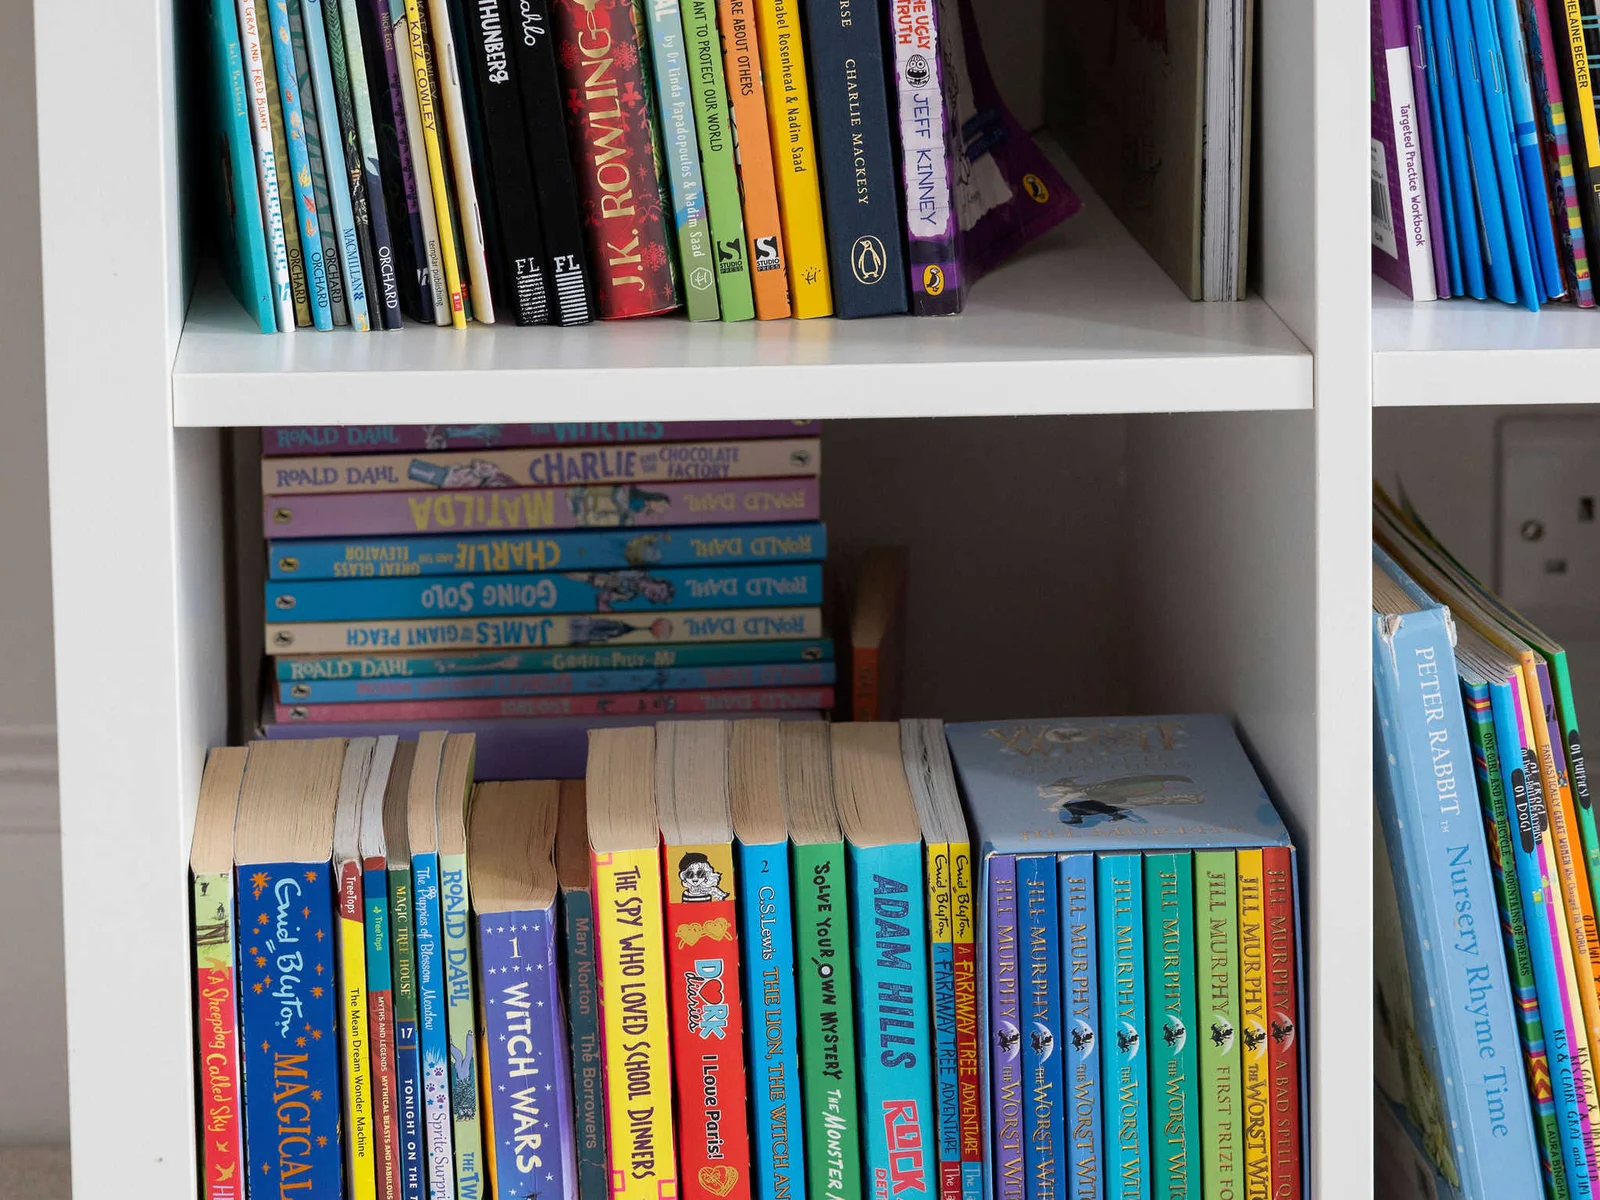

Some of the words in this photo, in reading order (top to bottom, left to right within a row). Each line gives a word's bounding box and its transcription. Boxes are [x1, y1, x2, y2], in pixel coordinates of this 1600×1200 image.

[244, 8, 256, 35] GRAY
[381, 12, 391, 30] Nick
[410, 21, 423, 58] KATZ
[695, 23, 708, 37] TO
[733, 18, 749, 53] ABOUT
[915, 16, 930, 50] UGLY
[250, 43, 259, 61] AND
[383, 33, 393, 51] East
[662, 34, 674, 48] by
[667, 52, 678, 63] Dr
[252, 70, 263, 93] FRED
[668, 67, 685, 98] Linda
[698, 41, 713, 87] PROTECT
[736, 57, 753, 96] OTHERS
[778, 34, 798, 92] Rosenhead
[1573, 46, 1588, 88] BECKER
[416, 68, 435, 131] COWLEY
[702, 89, 718, 110] OUR
[845, 58, 861, 126] CHARLIE
[256, 98, 268, 130] BLUNT
[578, 31, 635, 219] ROWLING
[706, 113, 723, 152] WORLD
[787, 108, 802, 143] Nadim
[913, 93, 930, 138] JEFF
[1400, 105, 1414, 148] Targeted
[671, 101, 693, 178] Papadopoulos
[792, 147, 806, 172] Saad
[852, 133, 869, 204] MACKESY
[1405, 152, 1419, 192] Practice
[917, 150, 936, 225] KINNEY
[684, 193, 700, 226] Nadim
[1411, 195, 1425, 247] Workbook
[343, 228, 361, 291] MACMILLAN
[429, 240, 439, 267] templar
[608, 229, 645, 291] J.K.
[689, 230, 703, 257] Saad
[290, 248, 306, 304] ORCHARD
[311, 252, 328, 308] ORCHARD
[325, 248, 341, 303] ORCHARD
[379, 246, 397, 309] ORCHARD
[433, 269, 444, 306] publishing
[277, 468, 338, 487] ROALD
[347, 466, 398, 484] DAHL
[529, 452, 636, 485] CHARLIE
[659, 448, 739, 468] CHOCOLATE
[668, 463, 729, 478] FACTORY
[409, 488, 554, 531] MATILDA
[334, 564, 374, 577] GLASS
[345, 546, 408, 563] ELEVATOR
[380, 562, 419, 576] GREAT
[455, 541, 560, 571] CHARLIE
[347, 628, 399, 646] PEACH
[408, 624, 457, 645] GIANT
[477, 618, 553, 645] JAMES
[684, 618, 735, 636] DAHL
[744, 616, 804, 634] ROALD
[291, 661, 351, 679] ROALD
[361, 658, 412, 676] DAHL
[1415, 647, 1445, 720] PETER
[1484, 733, 1494, 750] ONE
[1429, 728, 1460, 816] RABBIT
[1487, 753, 1499, 776] GIRL
[1542, 744, 1560, 807] FANTASTICALLY
[1572, 758, 1589, 798] PUPPIES!
[1491, 778, 1501, 796] AND
[1493, 799, 1504, 817] HER
[1517, 803, 1530, 832] DOG!
[1553, 810, 1564, 834] GREAT
[1496, 819, 1511, 856] BICYCLE
[1557, 837, 1569, 865] WOMEN
[417, 867, 430, 884] The
[614, 866, 641, 892] THE
[813, 861, 831, 912] SOLVE
[954, 855, 968, 888] Enid
[273, 878, 301, 943] Enid
[346, 876, 357, 913] TreeTops
[396, 886, 407, 922] MAGIC
[414, 888, 437, 925] Puppies
[443, 870, 466, 938] ROALD
[993, 876, 1013, 916] JILL
[1068, 876, 1085, 917] JILL
[1159, 871, 1177, 912] JILL
[1446, 844, 1480, 955] Nursery
[1504, 870, 1519, 923] MOUNTAINS
[615, 898, 643, 926] SPY
[759, 886, 776, 960] C.S.Lewis
[873, 874, 912, 970] ADAM
[957, 894, 970, 937] Blyton
[1514, 925, 1521, 935] OF
[374, 917, 383, 951] TreeTops
[398, 927, 409, 953] TREE
[418, 928, 432, 939] of
[574, 918, 590, 955] Mary
[817, 917, 834, 958] YOUR
[422, 941, 434, 983] Blossom
[619, 934, 645, 976] WHO
[997, 925, 1016, 1019] MURPHY
[1069, 924, 1089, 1019] MURPHY
[1163, 919, 1181, 1013] MURPHY
[1516, 937, 1530, 977] DREAMS
[275, 951, 303, 1038] Blyton
[351, 987, 360, 1007] The
[400, 960, 411, 996] HOUSE
[449, 949, 469, 1006] DAHL
[577, 961, 592, 1014] Norton
[763, 966, 779, 1004] THE
[812, 958, 836, 1005] OWN
[955, 960, 976, 1034] FARAWAY
[203, 988, 227, 1049] Sheepdog
[378, 996, 386, 1017] MYTHS
[422, 987, 435, 1030] Meadow
[622, 984, 648, 1035] LOVED
[685, 973, 700, 1033] diaries
[1463, 964, 1497, 1059] Rhyme
[352, 1010, 361, 1037] Mean
[765, 1010, 783, 1060] LION,
[878, 981, 916, 1069] HILLS
[353, 1040, 362, 1072] Dream
[380, 1039, 388, 1071] LEGENDS
[581, 1033, 596, 1061] The
[821, 1012, 842, 1080] MYSTERY
[959, 1041, 976, 1076] TREE
[206, 1053, 231, 1101] Called
[622, 1041, 651, 1100] SCHOOL
[703, 1065, 720, 1107] Love
[768, 1062, 785, 1100] THE
[355, 1075, 364, 1113] Wonder
[381, 1075, 389, 1113] MYTHICAL
[405, 1079, 415, 1135] TONIGHT
[583, 1067, 598, 1149] Borrowers
[1216, 1067, 1231, 1115] FIRST
[1276, 1077, 1288, 1112] BAD
[1483, 1066, 1510, 1138] Time
[210, 1106, 229, 1132] Sky
[383, 1116, 391, 1143] BEASTS
[510, 1087, 542, 1174] WARS
[961, 1082, 979, 1155] ADVENTURE
[1165, 1075, 1184, 1148] WORST
[357, 1116, 367, 1157] Machine
[408, 1141, 416, 1158] ON
[629, 1107, 656, 1180] DINNERS
[706, 1110, 724, 1159] Paris!
[770, 1104, 788, 1168] WITCH
[1218, 1123, 1232, 1172] PRIZE
[1277, 1120, 1289, 1167] SPELL
[1546, 1123, 1555, 1157] LAURA
[409, 1166, 417, 1189] THE
